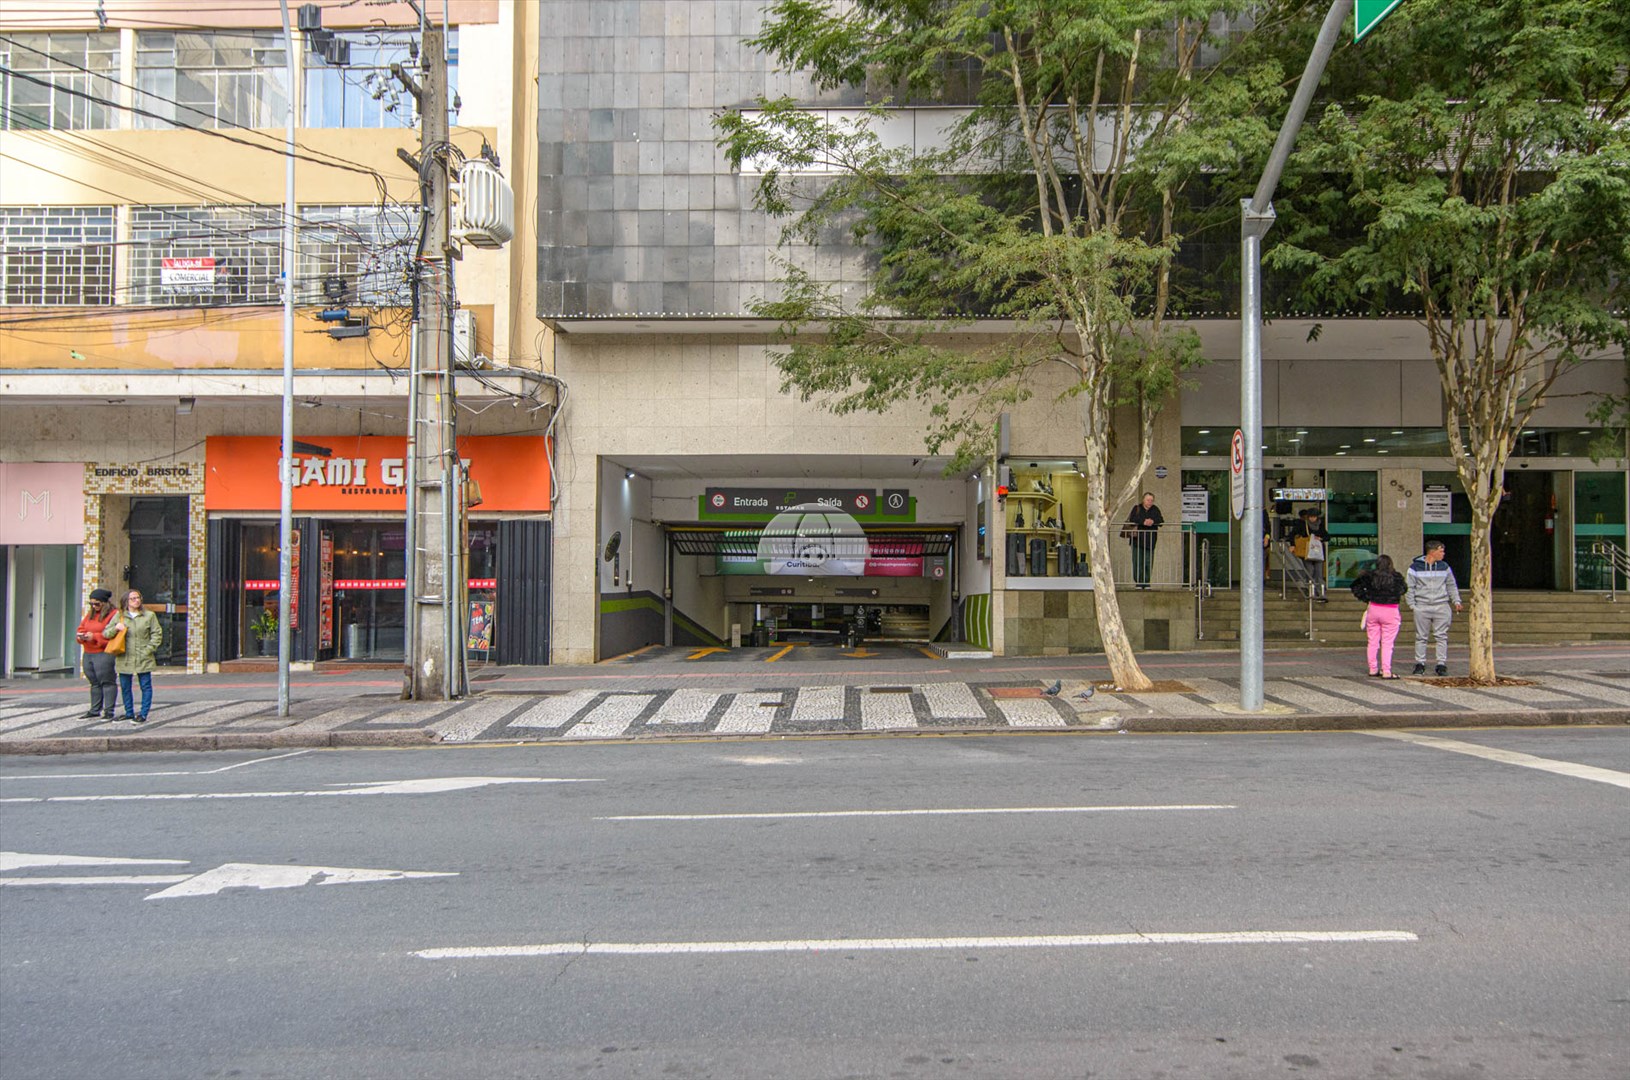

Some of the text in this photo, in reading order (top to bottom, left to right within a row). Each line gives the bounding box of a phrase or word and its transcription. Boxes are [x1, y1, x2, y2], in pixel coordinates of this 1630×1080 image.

[95, 467, 192, 477] EDIFICIO BRISTOL
[278, 456, 367, 487] GAMI
[733, 496, 843, 507] Entrada Saída
